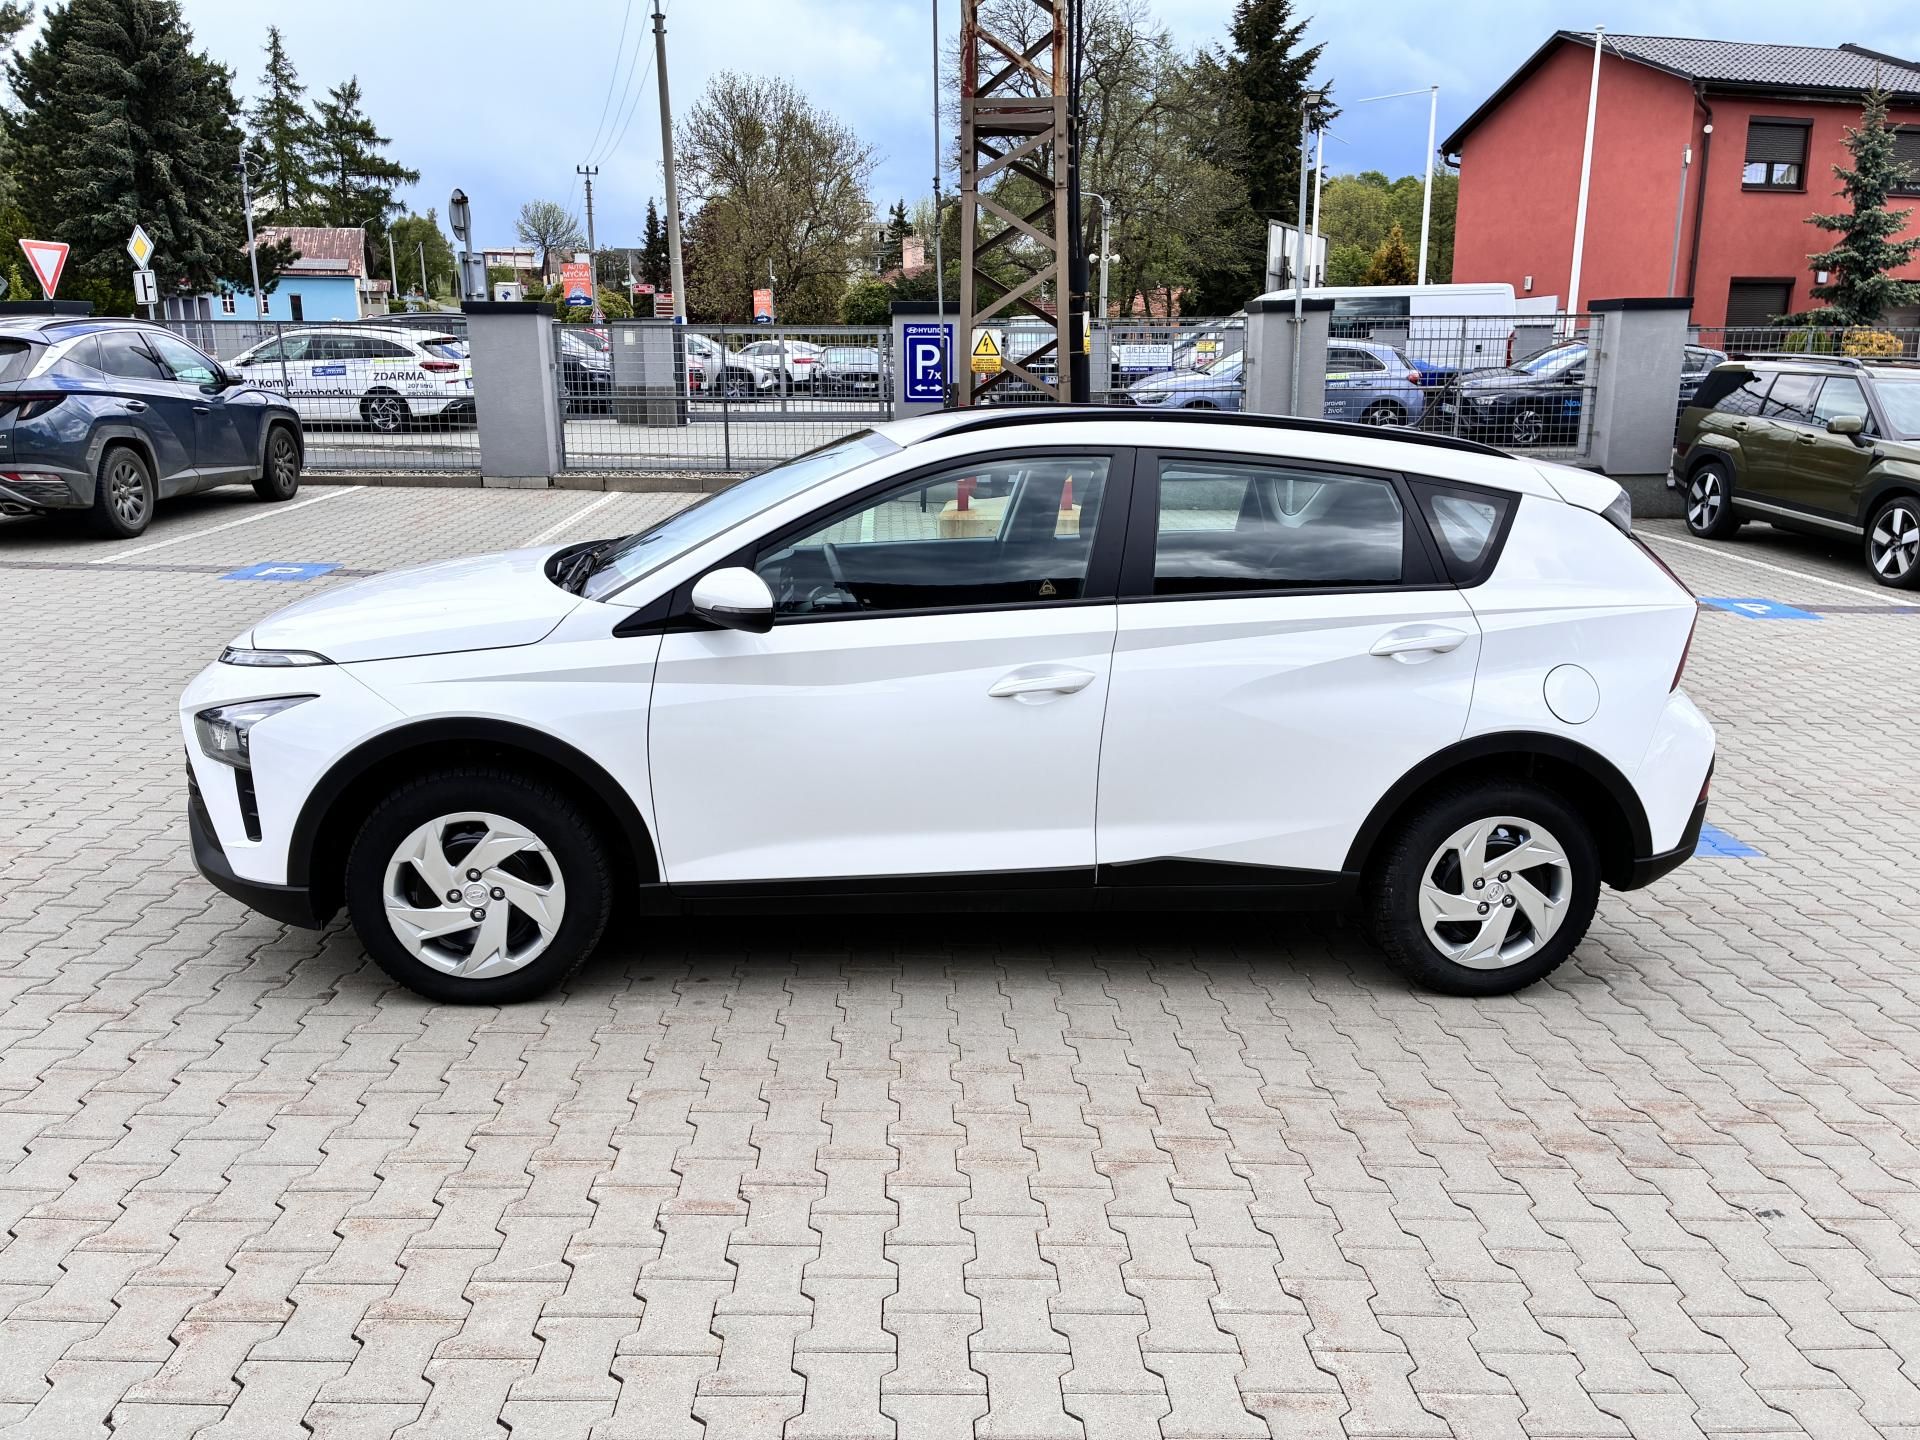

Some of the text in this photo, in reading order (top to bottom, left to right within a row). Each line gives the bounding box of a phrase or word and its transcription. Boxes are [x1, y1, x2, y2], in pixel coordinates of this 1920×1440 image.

[563, 270, 589, 278] MYČKA
[916, 344, 941, 380] P
[373, 372, 426, 381] ZDARMA
[927, 369, 942, 380] 7x
